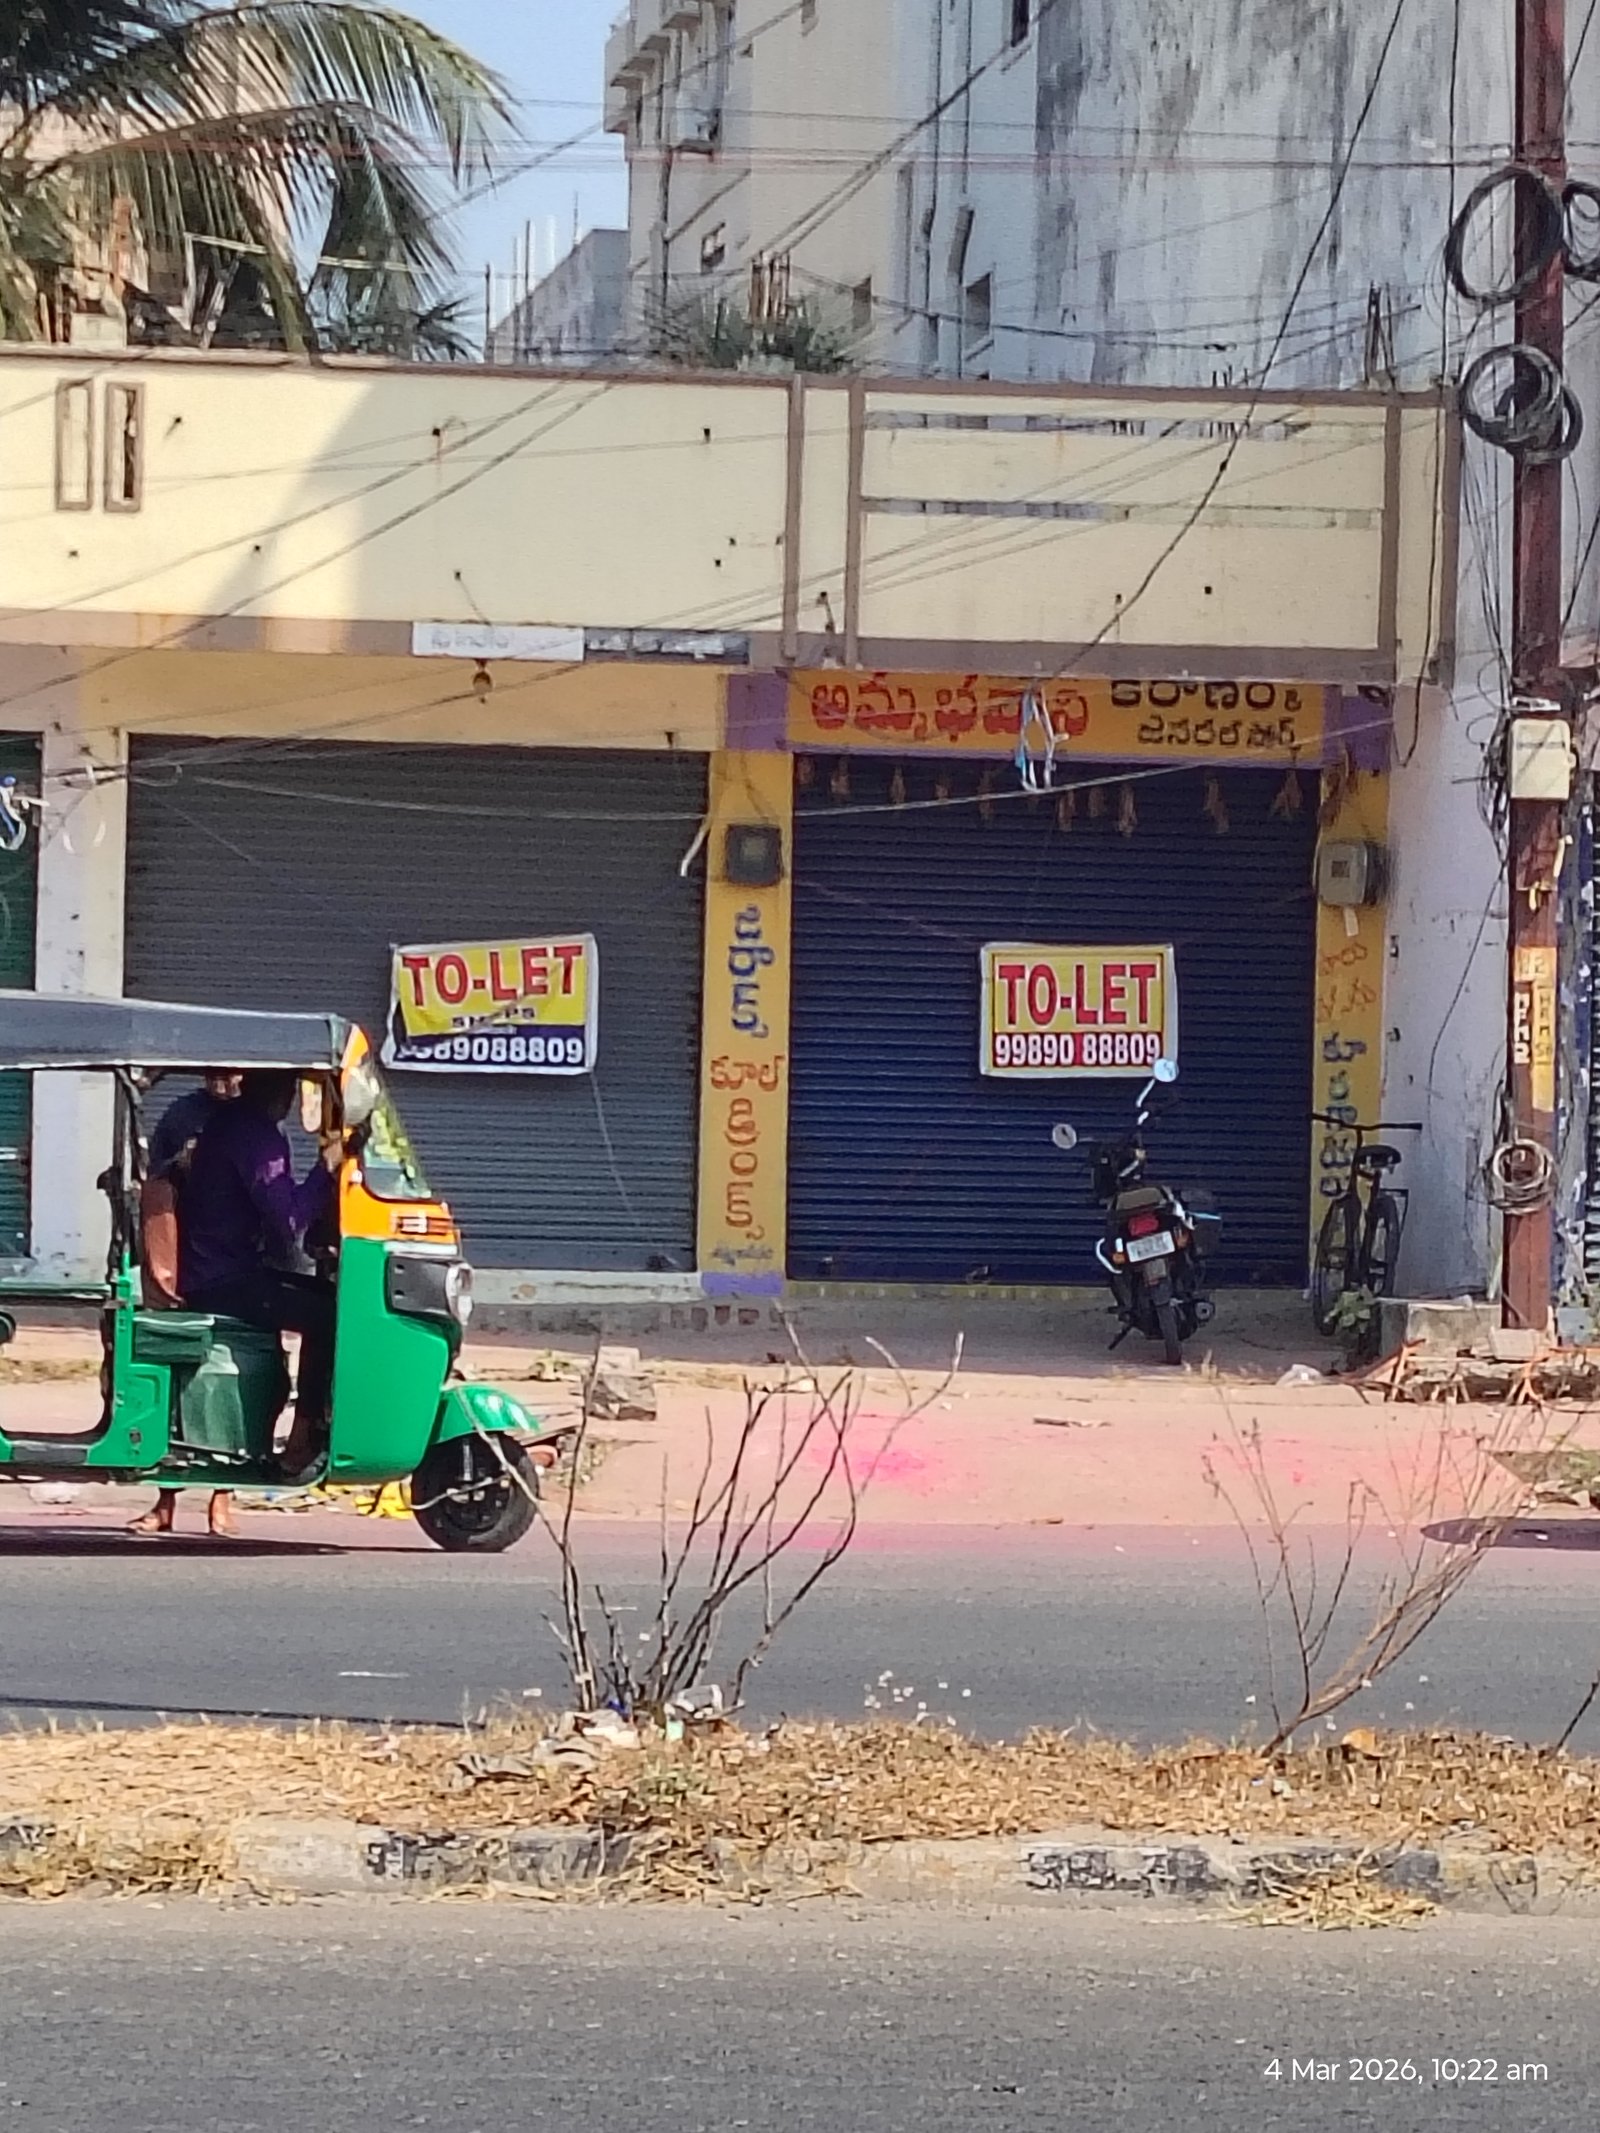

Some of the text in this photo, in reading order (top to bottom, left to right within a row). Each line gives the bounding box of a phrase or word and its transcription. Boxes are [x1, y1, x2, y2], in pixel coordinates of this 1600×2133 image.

[401, 944, 584, 1007] TO-LET
[998, 963, 1158, 1026] TO-LET
[994, 1033, 1072, 1067] 99890
